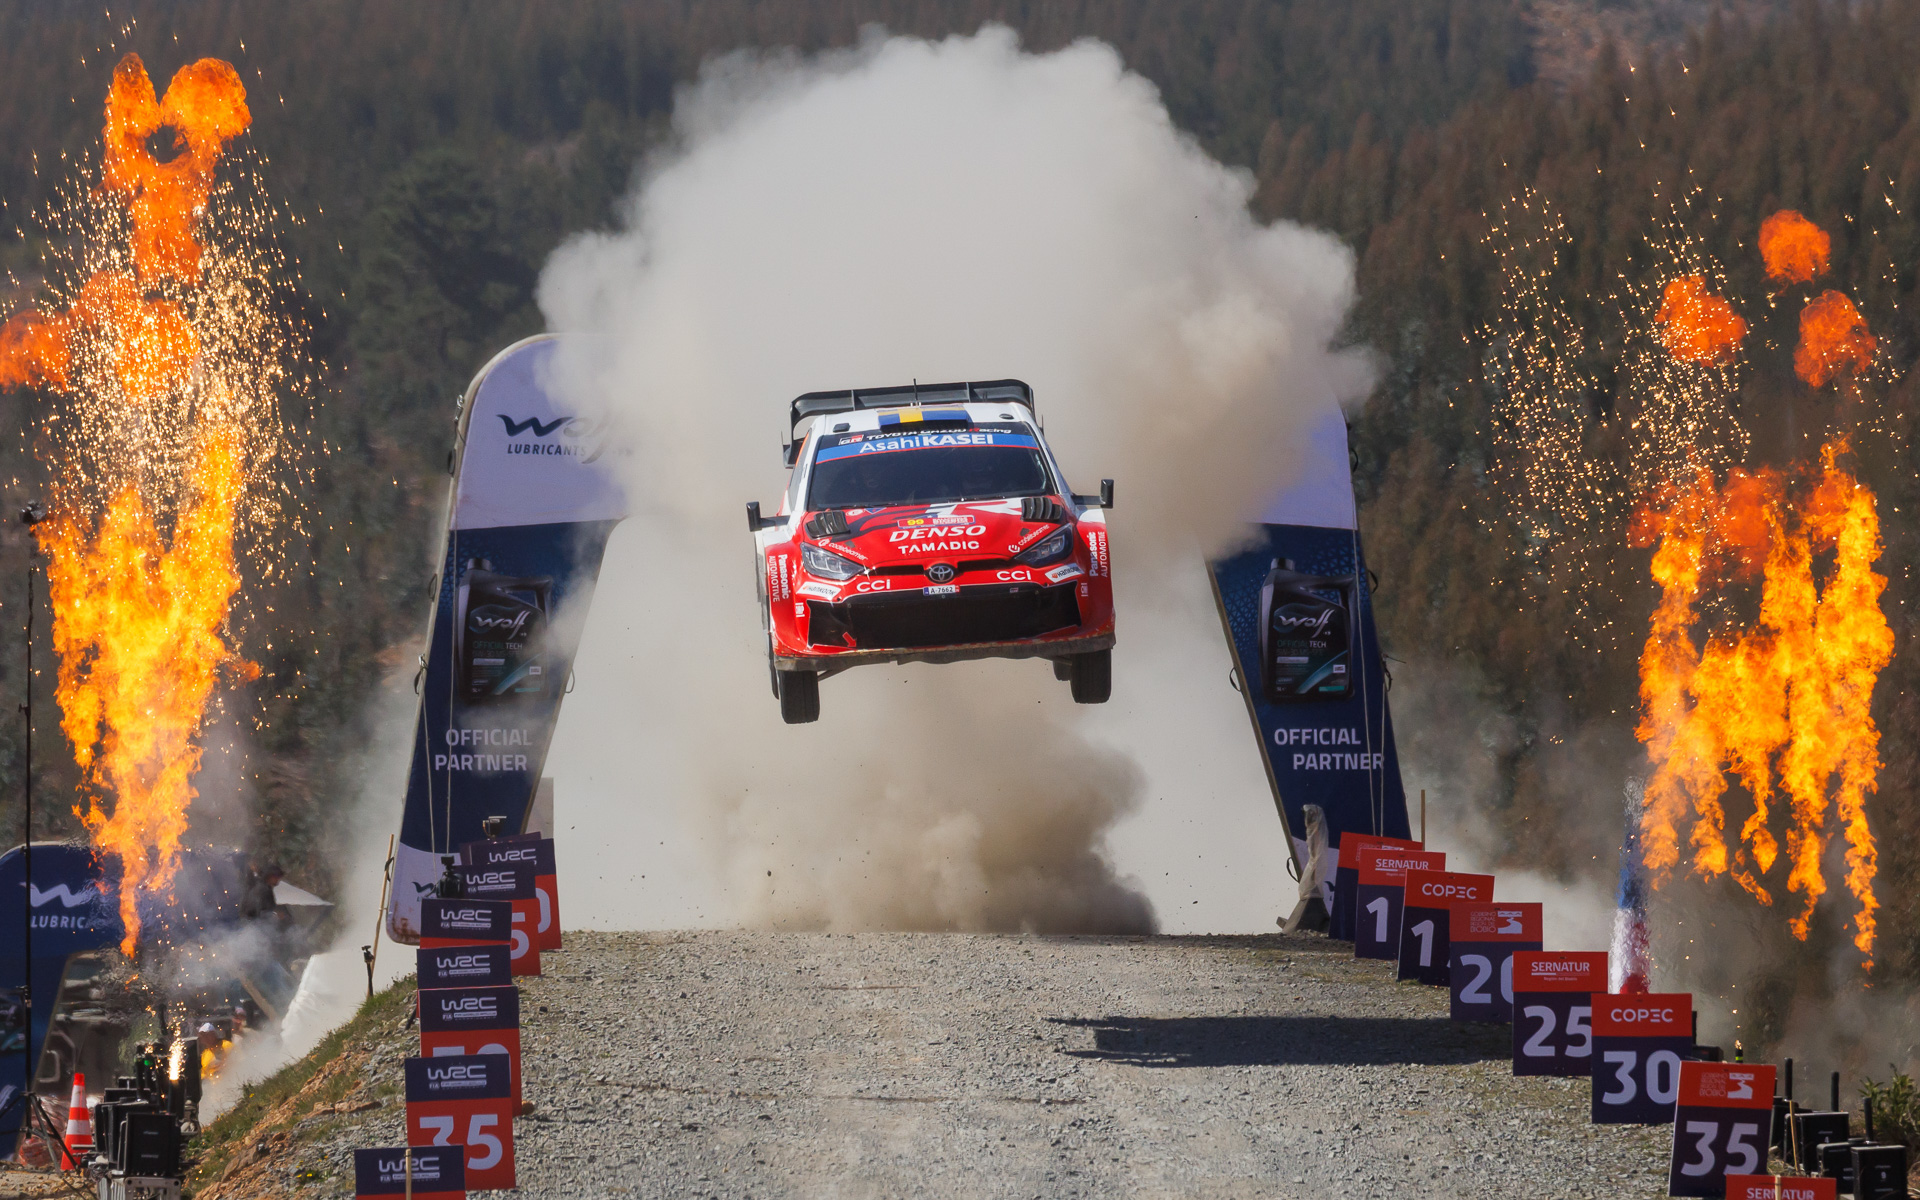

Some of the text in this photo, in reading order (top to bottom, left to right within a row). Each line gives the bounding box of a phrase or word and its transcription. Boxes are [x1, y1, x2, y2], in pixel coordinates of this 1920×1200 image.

[907, 518, 924, 526] 99
[889, 525, 987, 543] DENSO
[898, 541, 980, 555] TAMADIC
[1086, 531, 1099, 578] Panasonic
[768, 555, 780, 603] AUTOMOTIVE
[778, 553, 790, 600] Panasonic
[930, 586, 953, 595] A-7662
[445, 728, 532, 746] OFFICIAL
[1274, 728, 1361, 745] OFFICIAL
[435, 754, 527, 771] PARTNER
[1293, 753, 1384, 770] PARTNER
[489, 848, 537, 863] WRC
[1375, 858, 1429, 870] SERNATUR
[466, 871, 516, 885] WRC
[1422, 883, 1477, 899] COPEC
[441, 908, 492, 922] WRC
[436, 954, 490, 969] WRC
[1531, 961, 1590, 972] SERNATUR
[441, 996, 497, 1011] WRC
[1611, 1008, 1673, 1023] COPEC
[1523, 1005, 1592, 1057] 25
[427, 1064, 487, 1080] WRC
[1602, 1050, 1681, 1105] 30
[1681, 1120, 1759, 1176] 35
[378, 1156, 440, 1172] WRC
